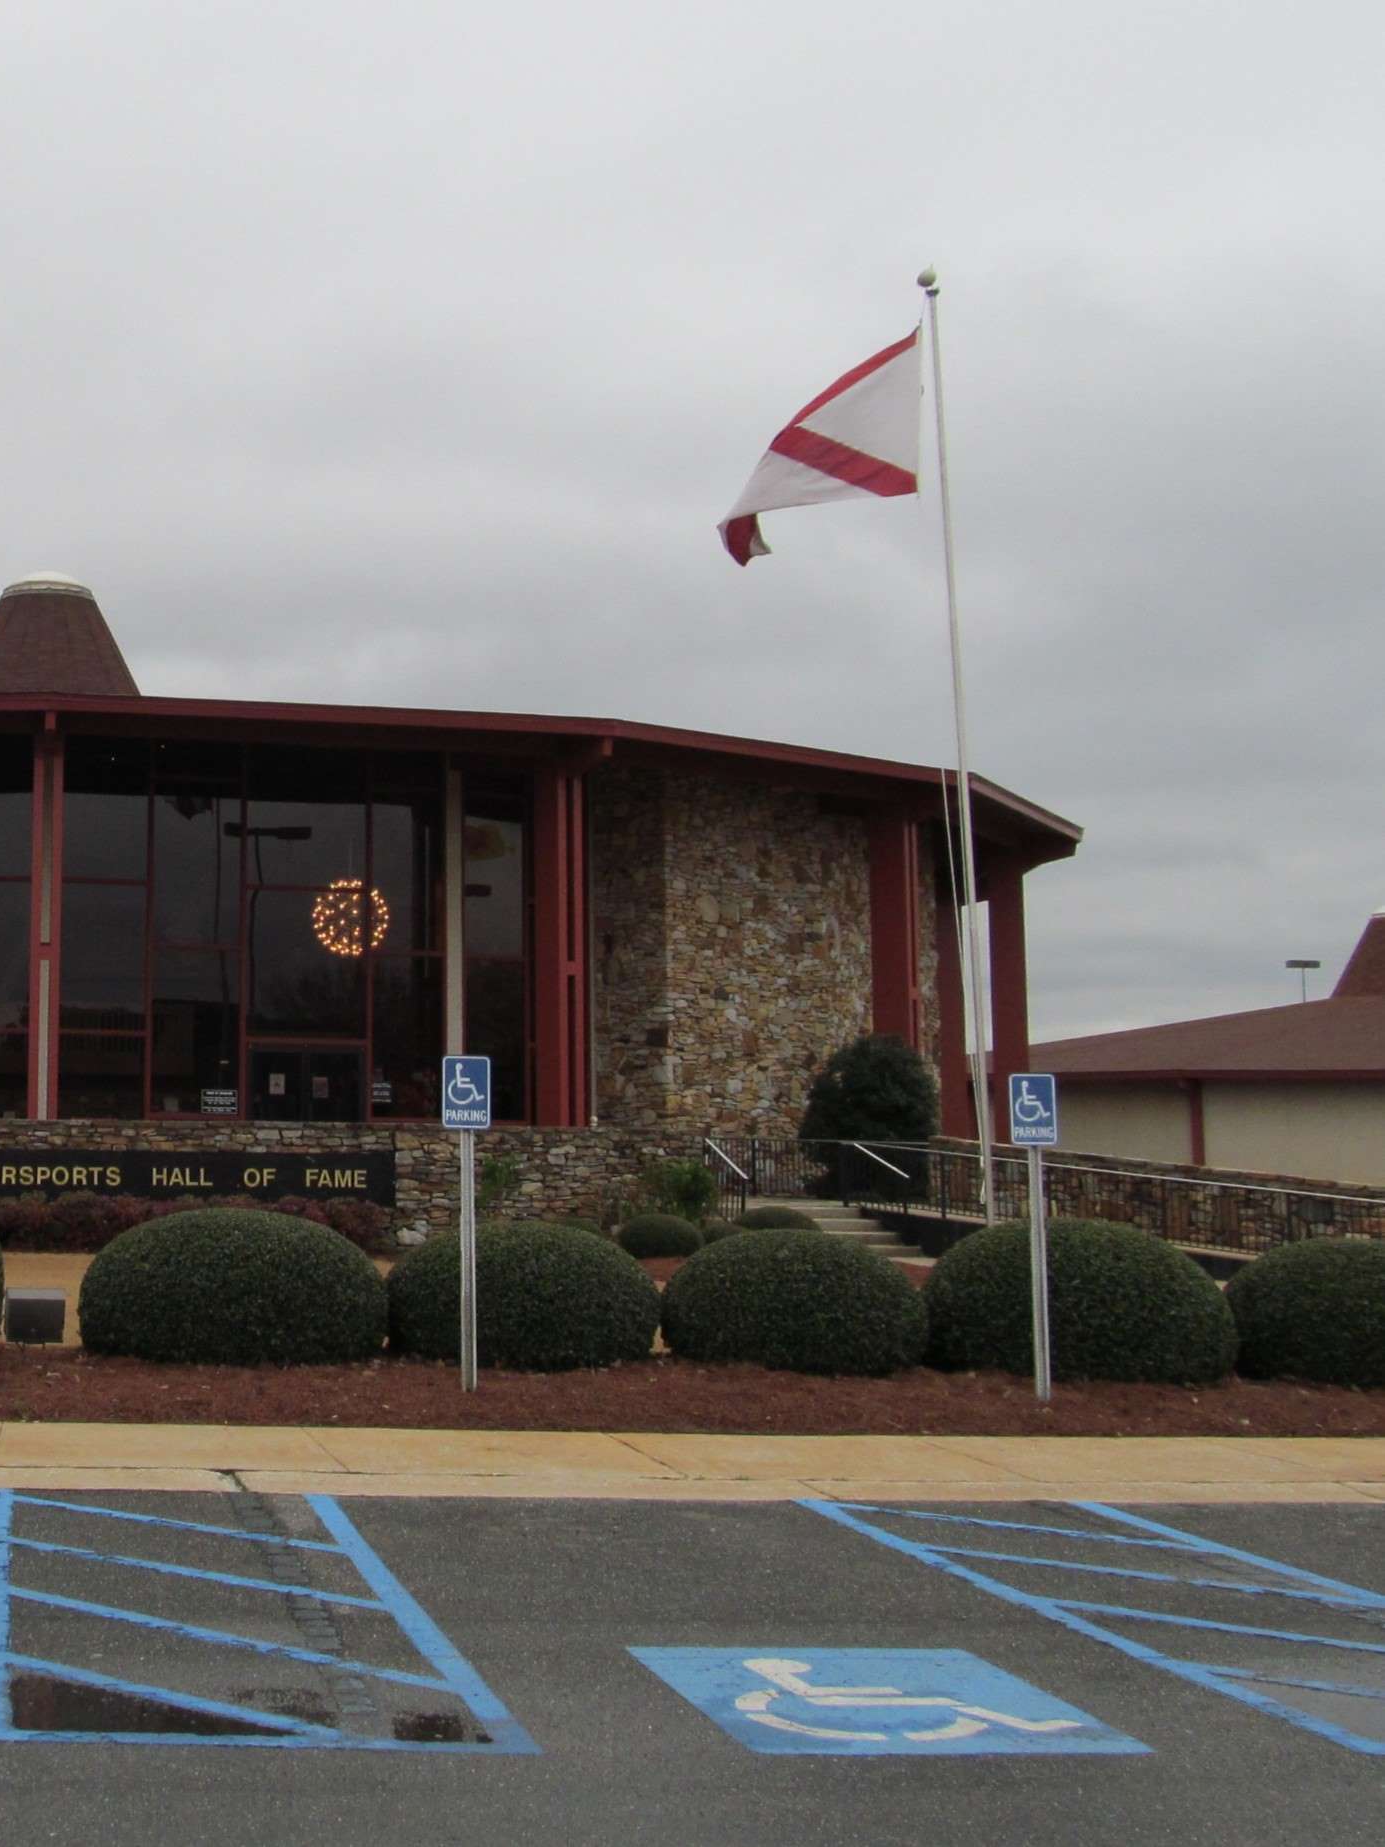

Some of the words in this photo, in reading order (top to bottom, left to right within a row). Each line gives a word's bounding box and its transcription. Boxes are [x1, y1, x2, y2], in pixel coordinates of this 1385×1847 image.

[446, 1109, 488, 1123] PARKING
[1014, 1126, 1054, 1139] PARKING
[152, 1167, 213, 1187] HALL
[244, 1167, 276, 1187] OF
[306, 1168, 367, 1188] FAME
